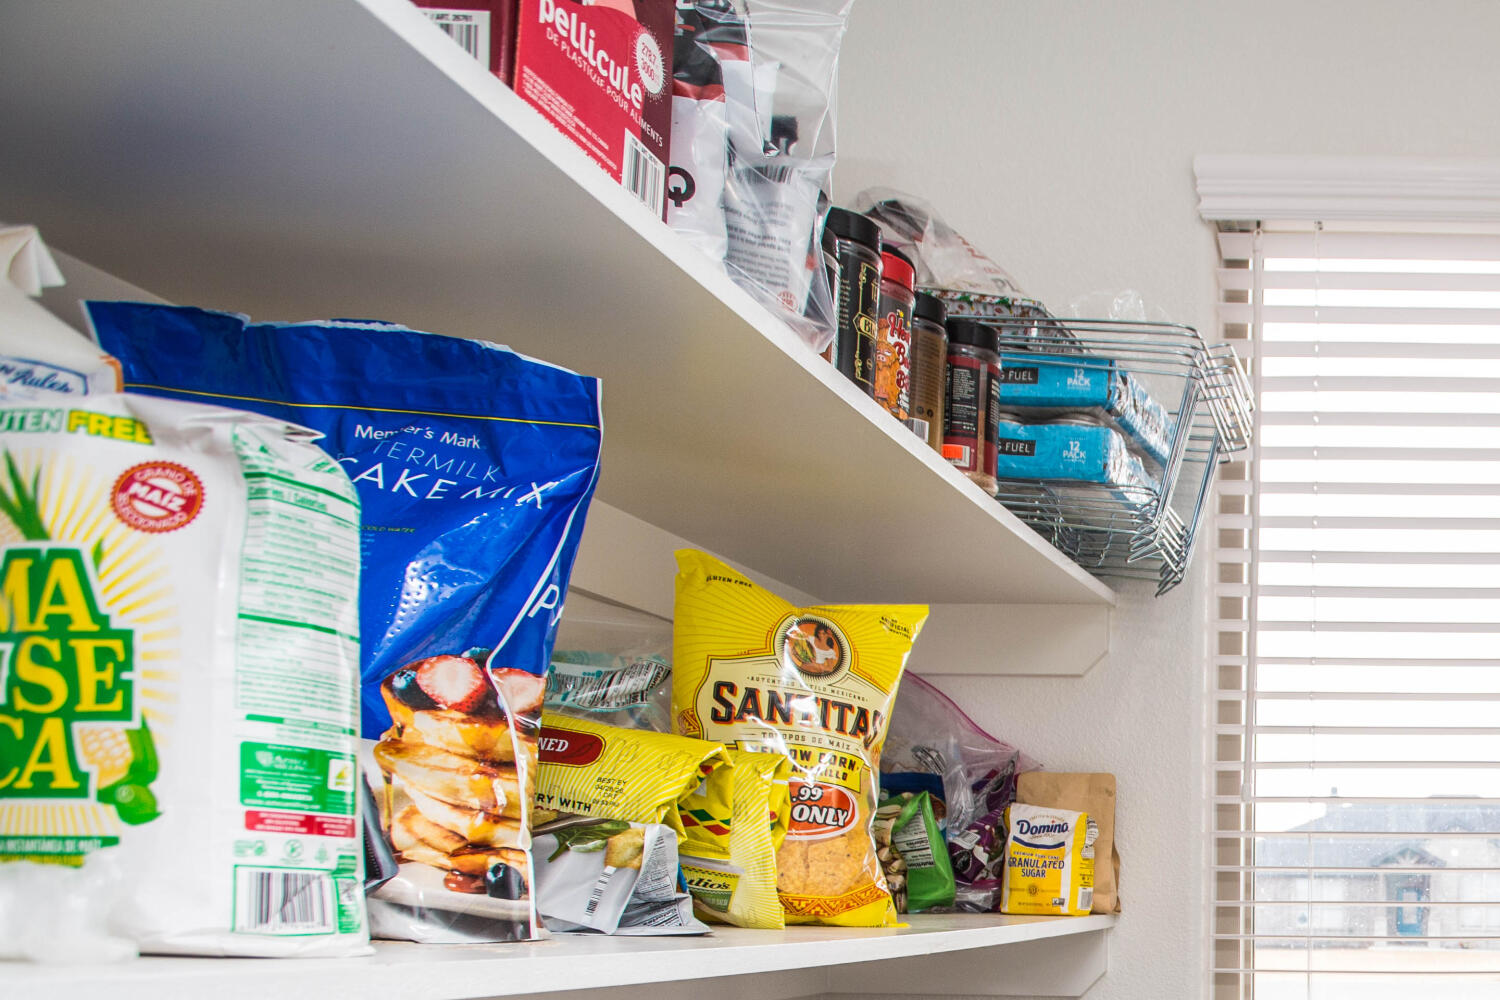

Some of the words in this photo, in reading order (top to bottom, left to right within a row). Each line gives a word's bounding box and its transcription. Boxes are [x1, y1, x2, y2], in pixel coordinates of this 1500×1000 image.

[538, 0, 643, 110] pellicule
[546, 27, 559, 46] DE
[561, 42, 605, 93] PLASTIQUE
[606, 85, 629, 113] POUR
[630, 110, 664, 148] ALIMENTS
[1008, 369, 1033, 381] FUEL
[1066, 377, 1091, 387] PACK
[439, 431, 481, 450] Mark
[1068, 440, 1080, 451] 12
[1005, 442, 1031, 454] FUEL
[1062, 449, 1087, 460] PACK
[811, 736, 823, 745] DE
[560, 796, 593, 813] WITH
[792, 803, 849, 828] ONLY
[1016, 818, 1069, 836] Domino
[1007, 856, 1065, 870] GRANULATED
[1021, 868, 1046, 878] SUGAR
